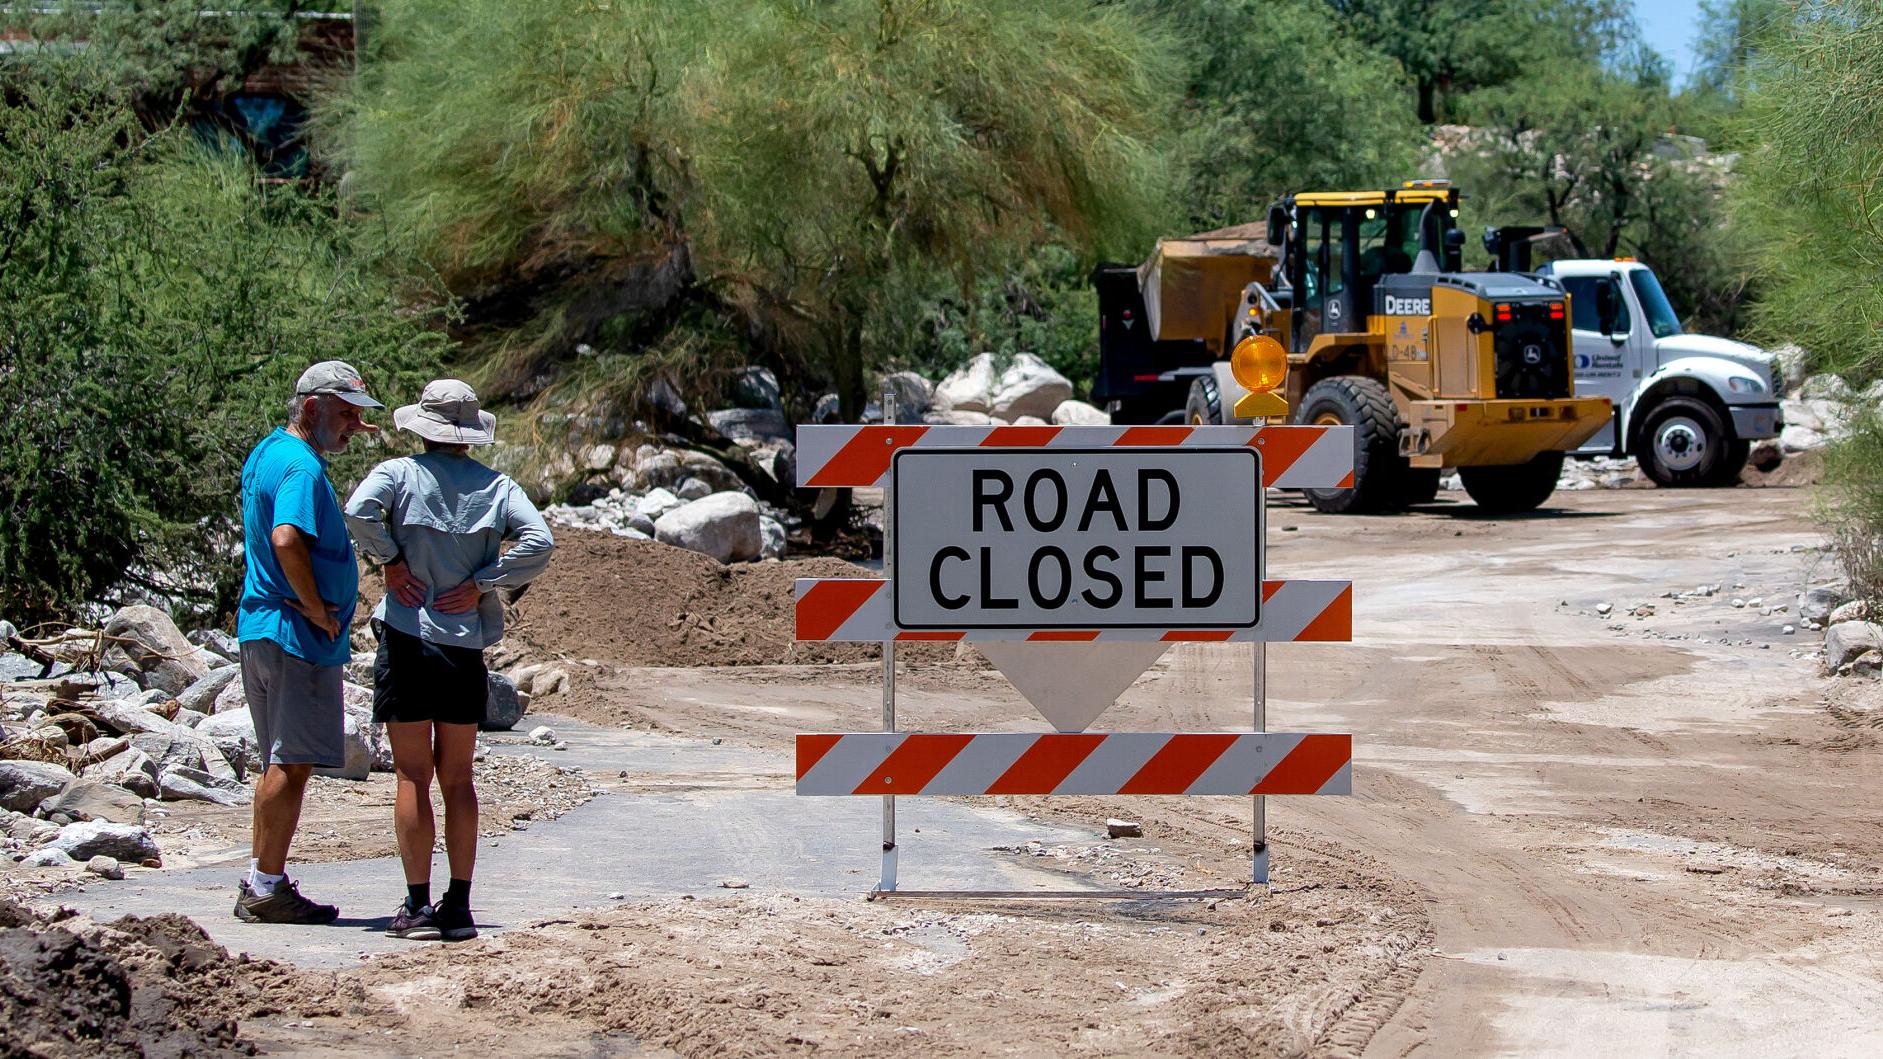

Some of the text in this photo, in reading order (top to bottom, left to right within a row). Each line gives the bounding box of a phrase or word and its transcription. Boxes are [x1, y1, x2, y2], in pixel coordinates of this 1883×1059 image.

[1385, 295, 1431, 315] DEERE
[972, 468, 1181, 533] ROAD
[929, 545, 1225, 610] CLOSED
